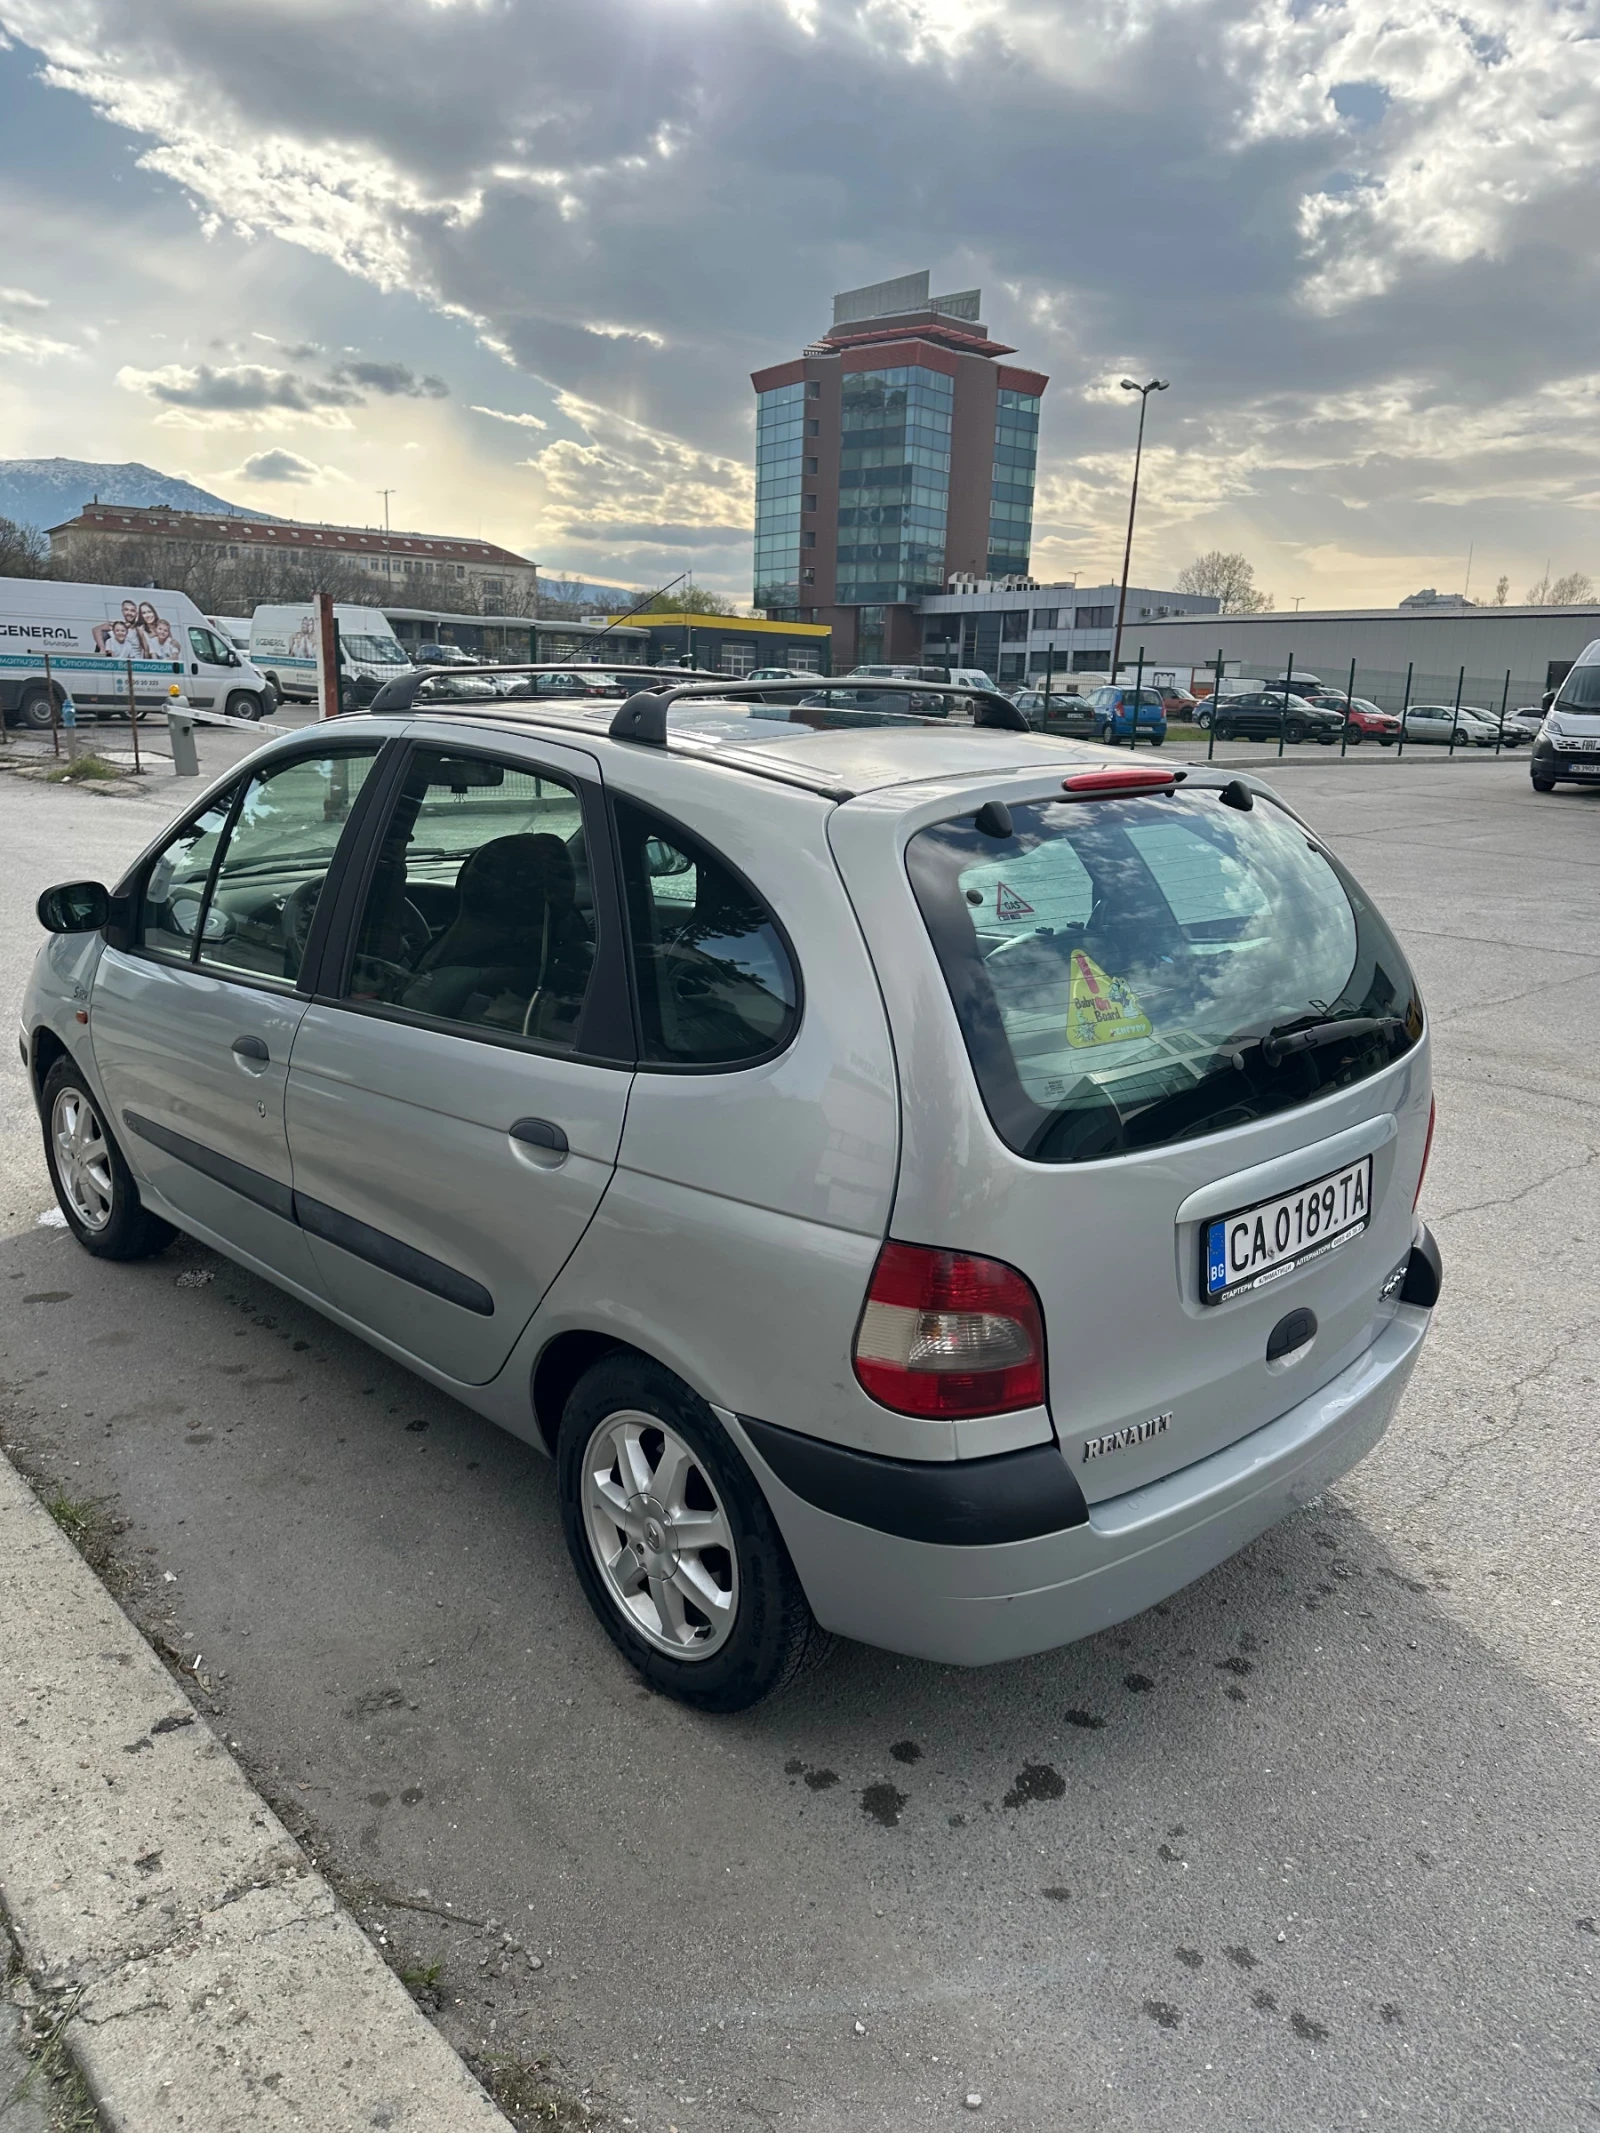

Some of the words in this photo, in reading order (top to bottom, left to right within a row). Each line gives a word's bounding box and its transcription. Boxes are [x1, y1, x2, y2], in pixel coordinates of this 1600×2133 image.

[0, 624, 78, 639] GENERAL
[117, 661, 173, 672] Ветилация
[1582, 739, 1598, 750] FIAT
[1004, 901, 1021, 910] GAS
[1074, 996, 1096, 1010] Baby
[1095, 996, 1112, 1012] On
[1094, 1007, 1121, 1023] Board
[1275, 1185, 1336, 1253] 0189
[1211, 1262, 1225, 1281] BG
[1221, 1282, 1253, 1301] СТАРТЕРИ
[1258, 1264, 1293, 1285] КЛИМАТИЦИ
[1084, 1411, 1173, 1462] RENAULT
